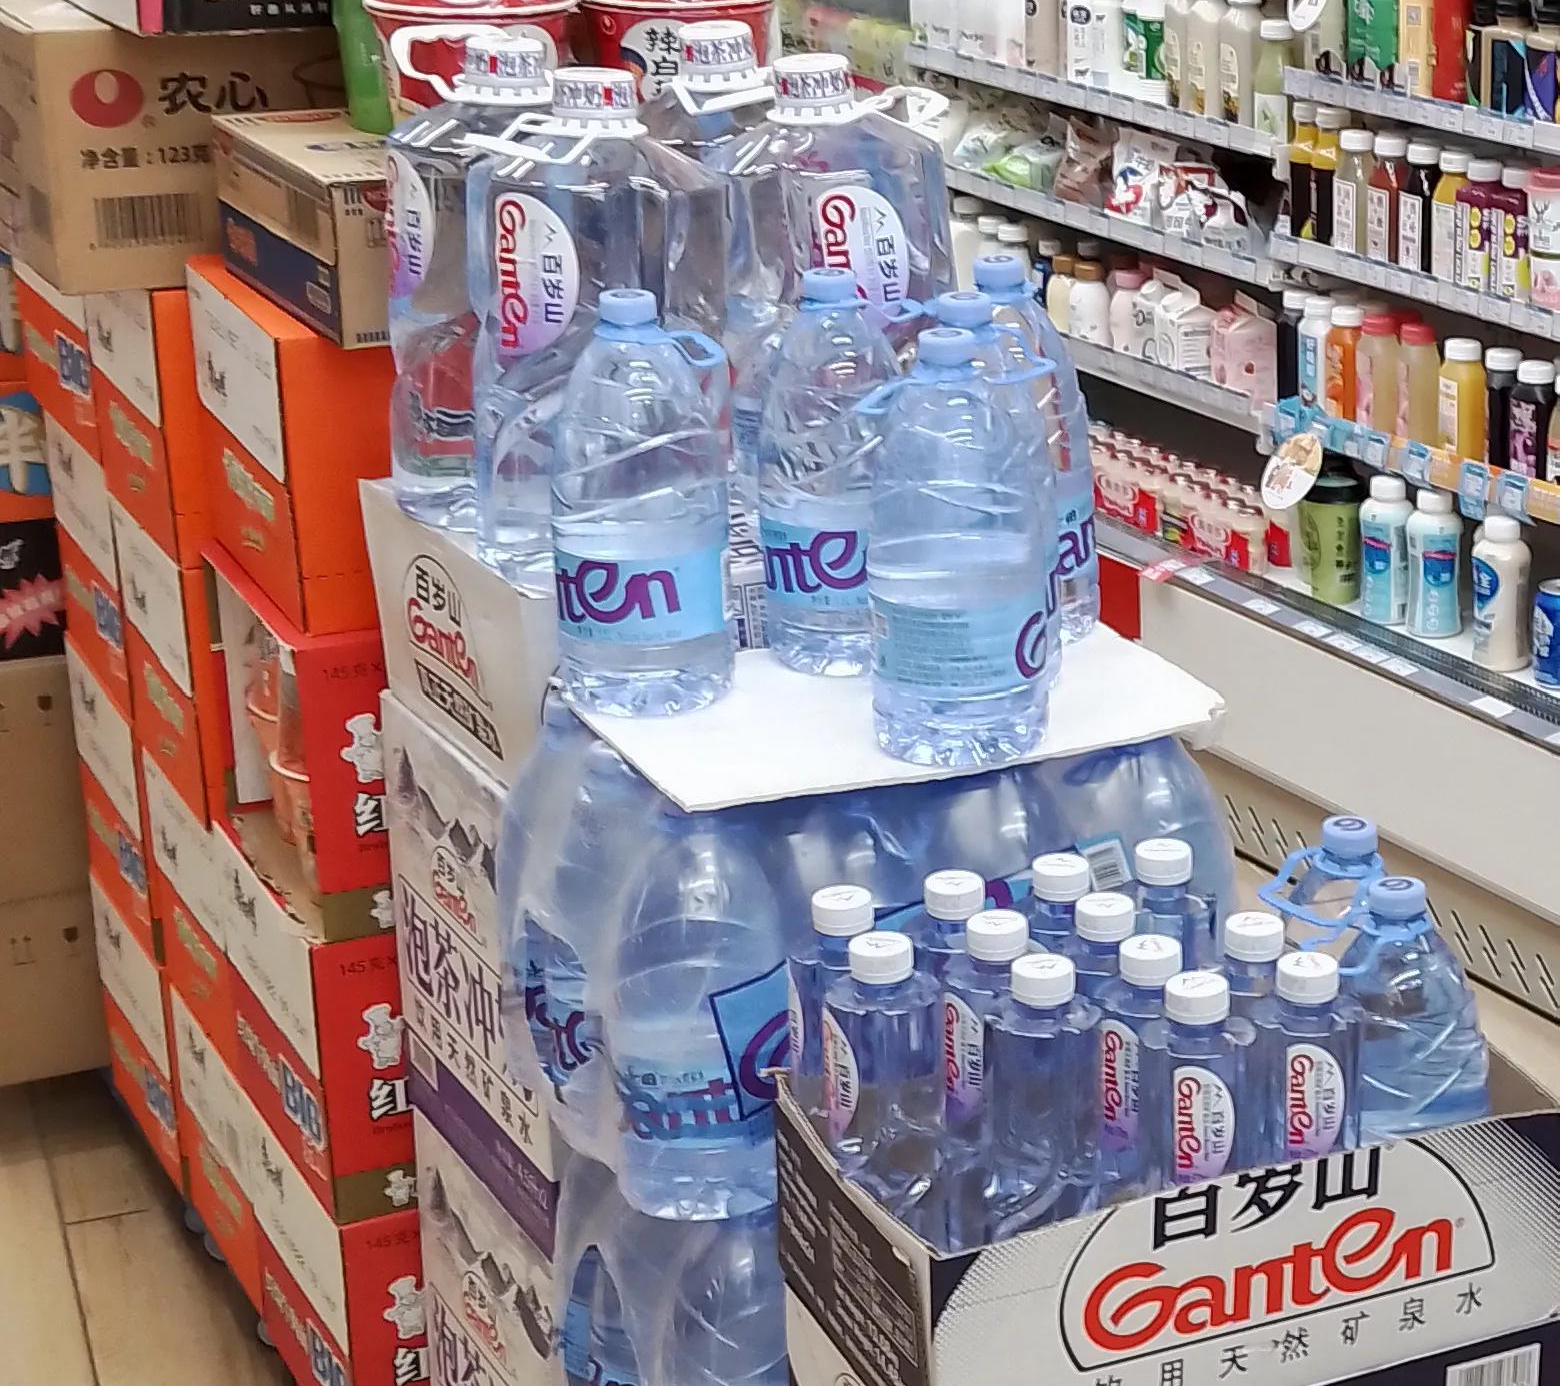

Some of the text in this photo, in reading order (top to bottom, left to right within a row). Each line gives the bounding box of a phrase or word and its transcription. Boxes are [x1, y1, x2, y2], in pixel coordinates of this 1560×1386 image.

[158, 72, 269, 115] 农心
[498, 199, 530, 350] Ganten
[541, 253, 564, 326] 百岁山
[875, 235, 902, 304] 百岁山
[402, 883, 504, 1061] 泡茶冲
[1174, 1074, 1204, 1171] Ganten
[1289, 1052, 1316, 1147] Ganten
[1081, 1206, 1457, 1352] Ganten
